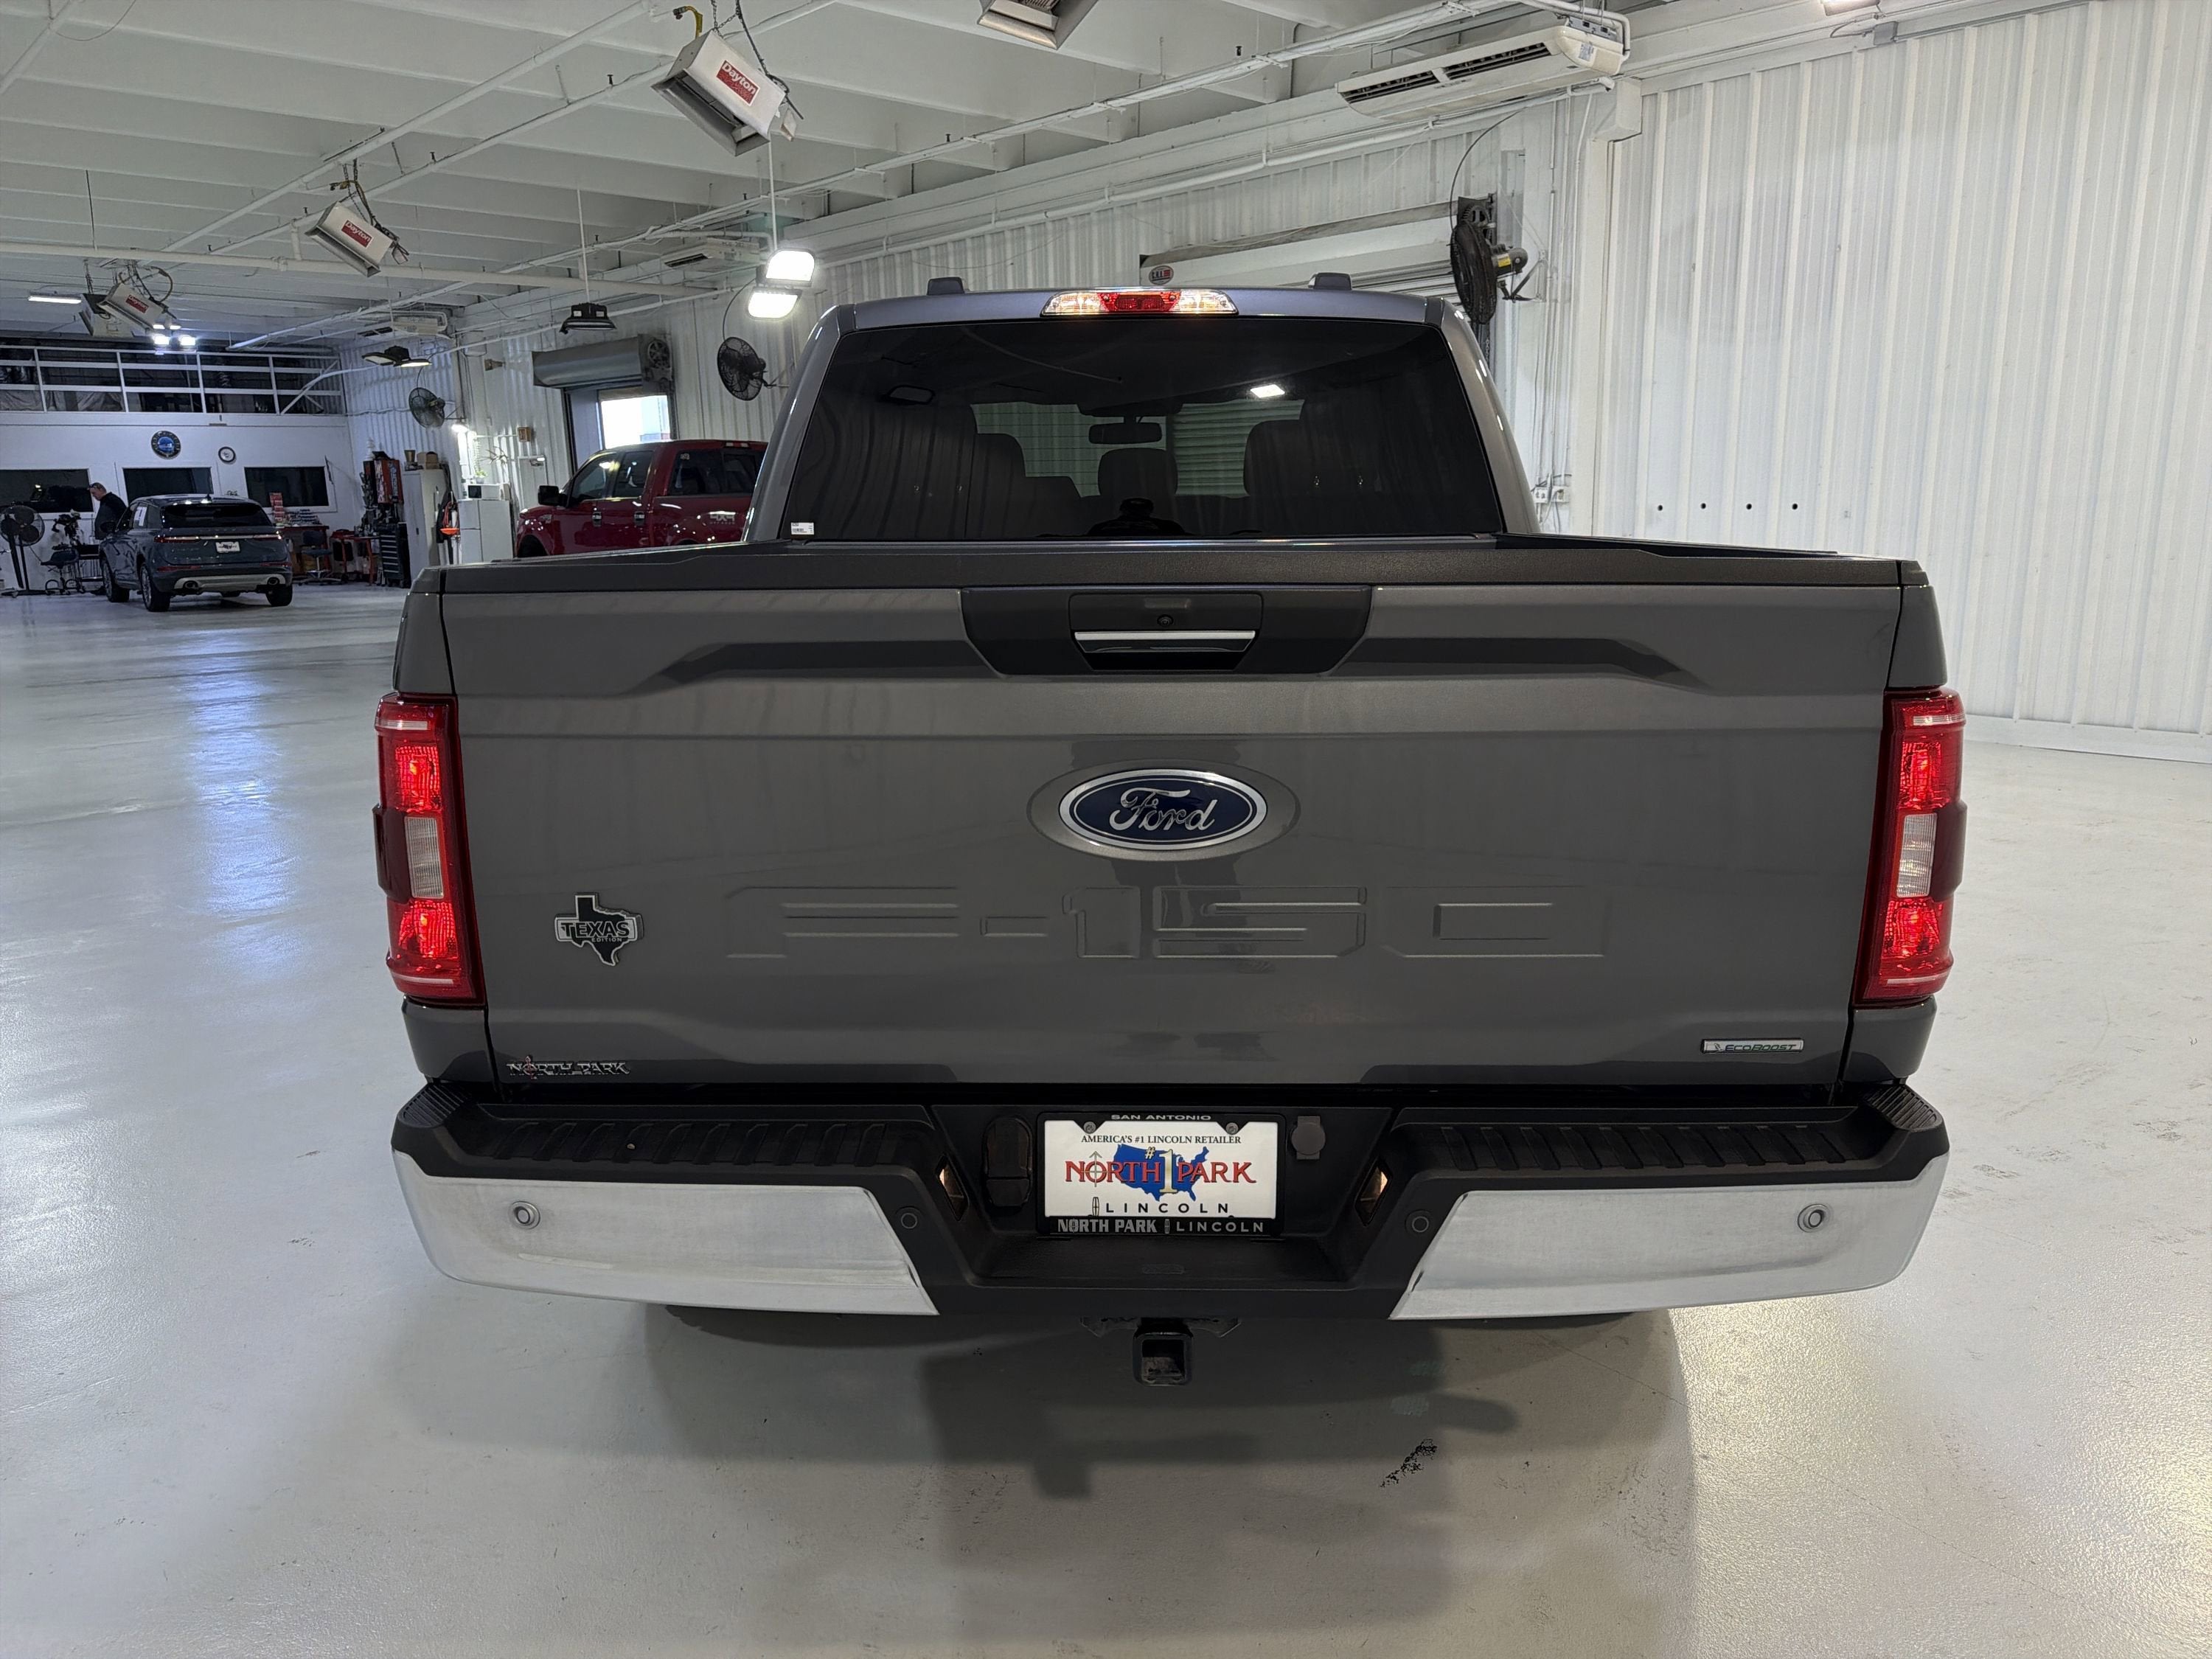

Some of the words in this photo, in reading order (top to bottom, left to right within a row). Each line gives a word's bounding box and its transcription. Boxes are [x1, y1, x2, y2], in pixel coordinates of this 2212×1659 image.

[721, 62, 757, 94] Dayton
[345, 221, 372, 242] Dayton
[1109, 787, 1218, 831] Ford
[560, 921, 630, 938] TEXAS
[506, 1062, 573, 1075] NORTH
[577, 1062, 630, 1075] PARK
[1148, 1135, 1192, 1144] LINCOLN
[1065, 1161, 1161, 1183] NORTH
[1177, 1161, 1256, 1183] PARK
[1106, 1203, 1228, 1214] LINCOLN
[1057, 1219, 1109, 1233] NORTH
[1115, 1219, 1157, 1233] PARK
[1176, 1222, 1264, 1233] LINCOLN
